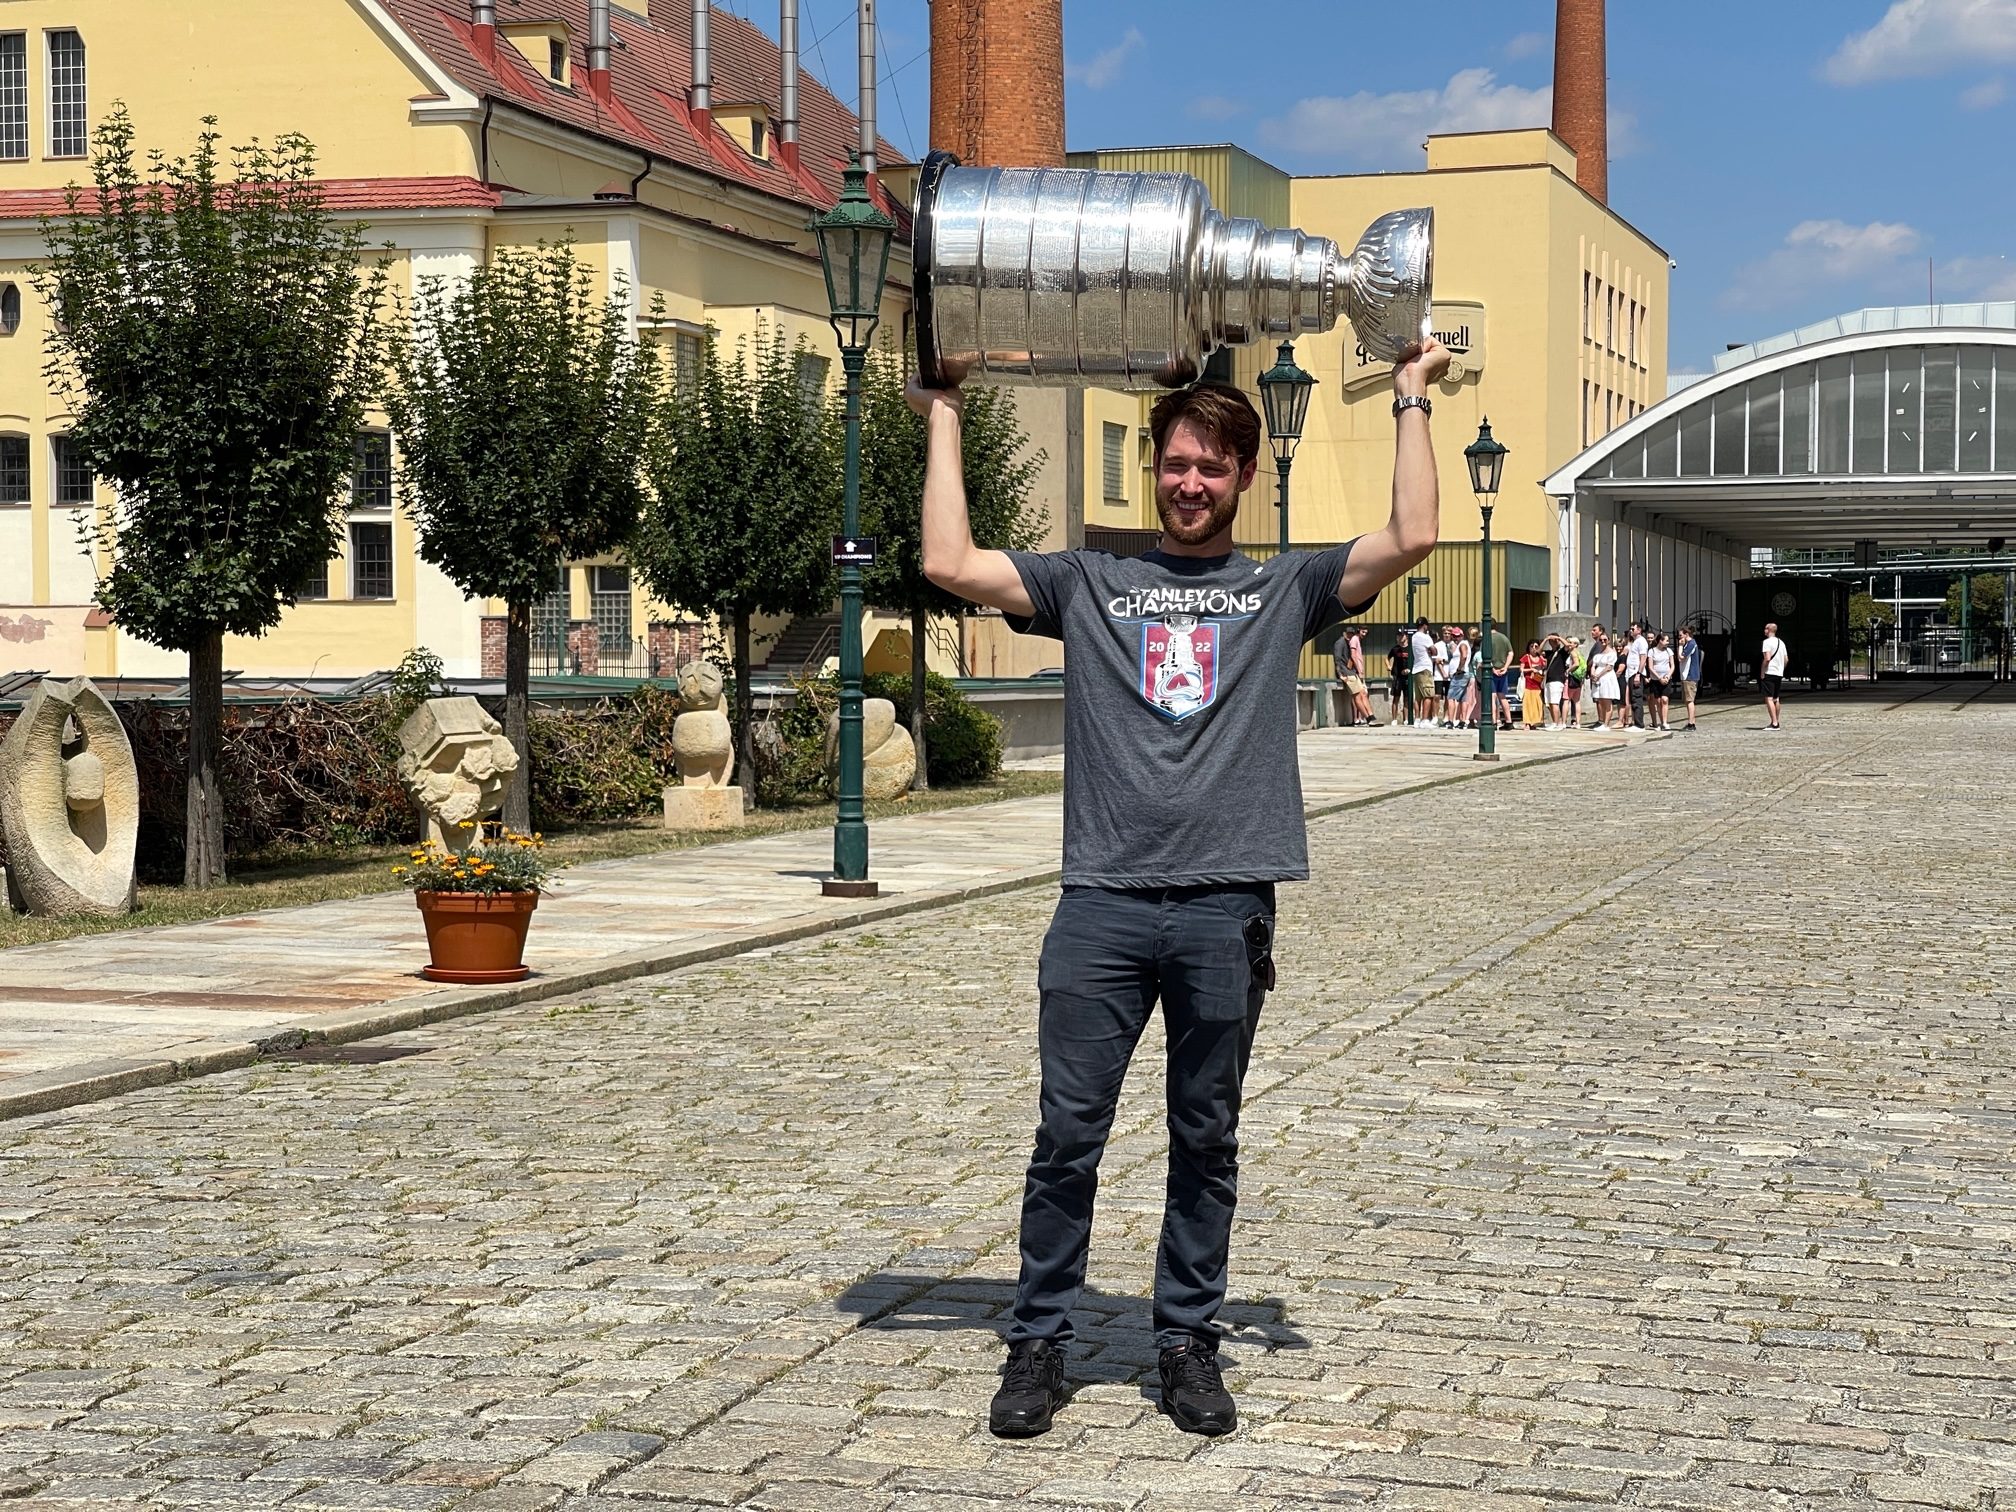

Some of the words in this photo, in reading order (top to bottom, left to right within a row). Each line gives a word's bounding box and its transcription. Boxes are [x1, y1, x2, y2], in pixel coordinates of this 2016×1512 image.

[1108, 593, 1262, 617] CHAMPIONS
[1149, 642, 1164, 652] 20
[1195, 642, 1211, 652] 22
